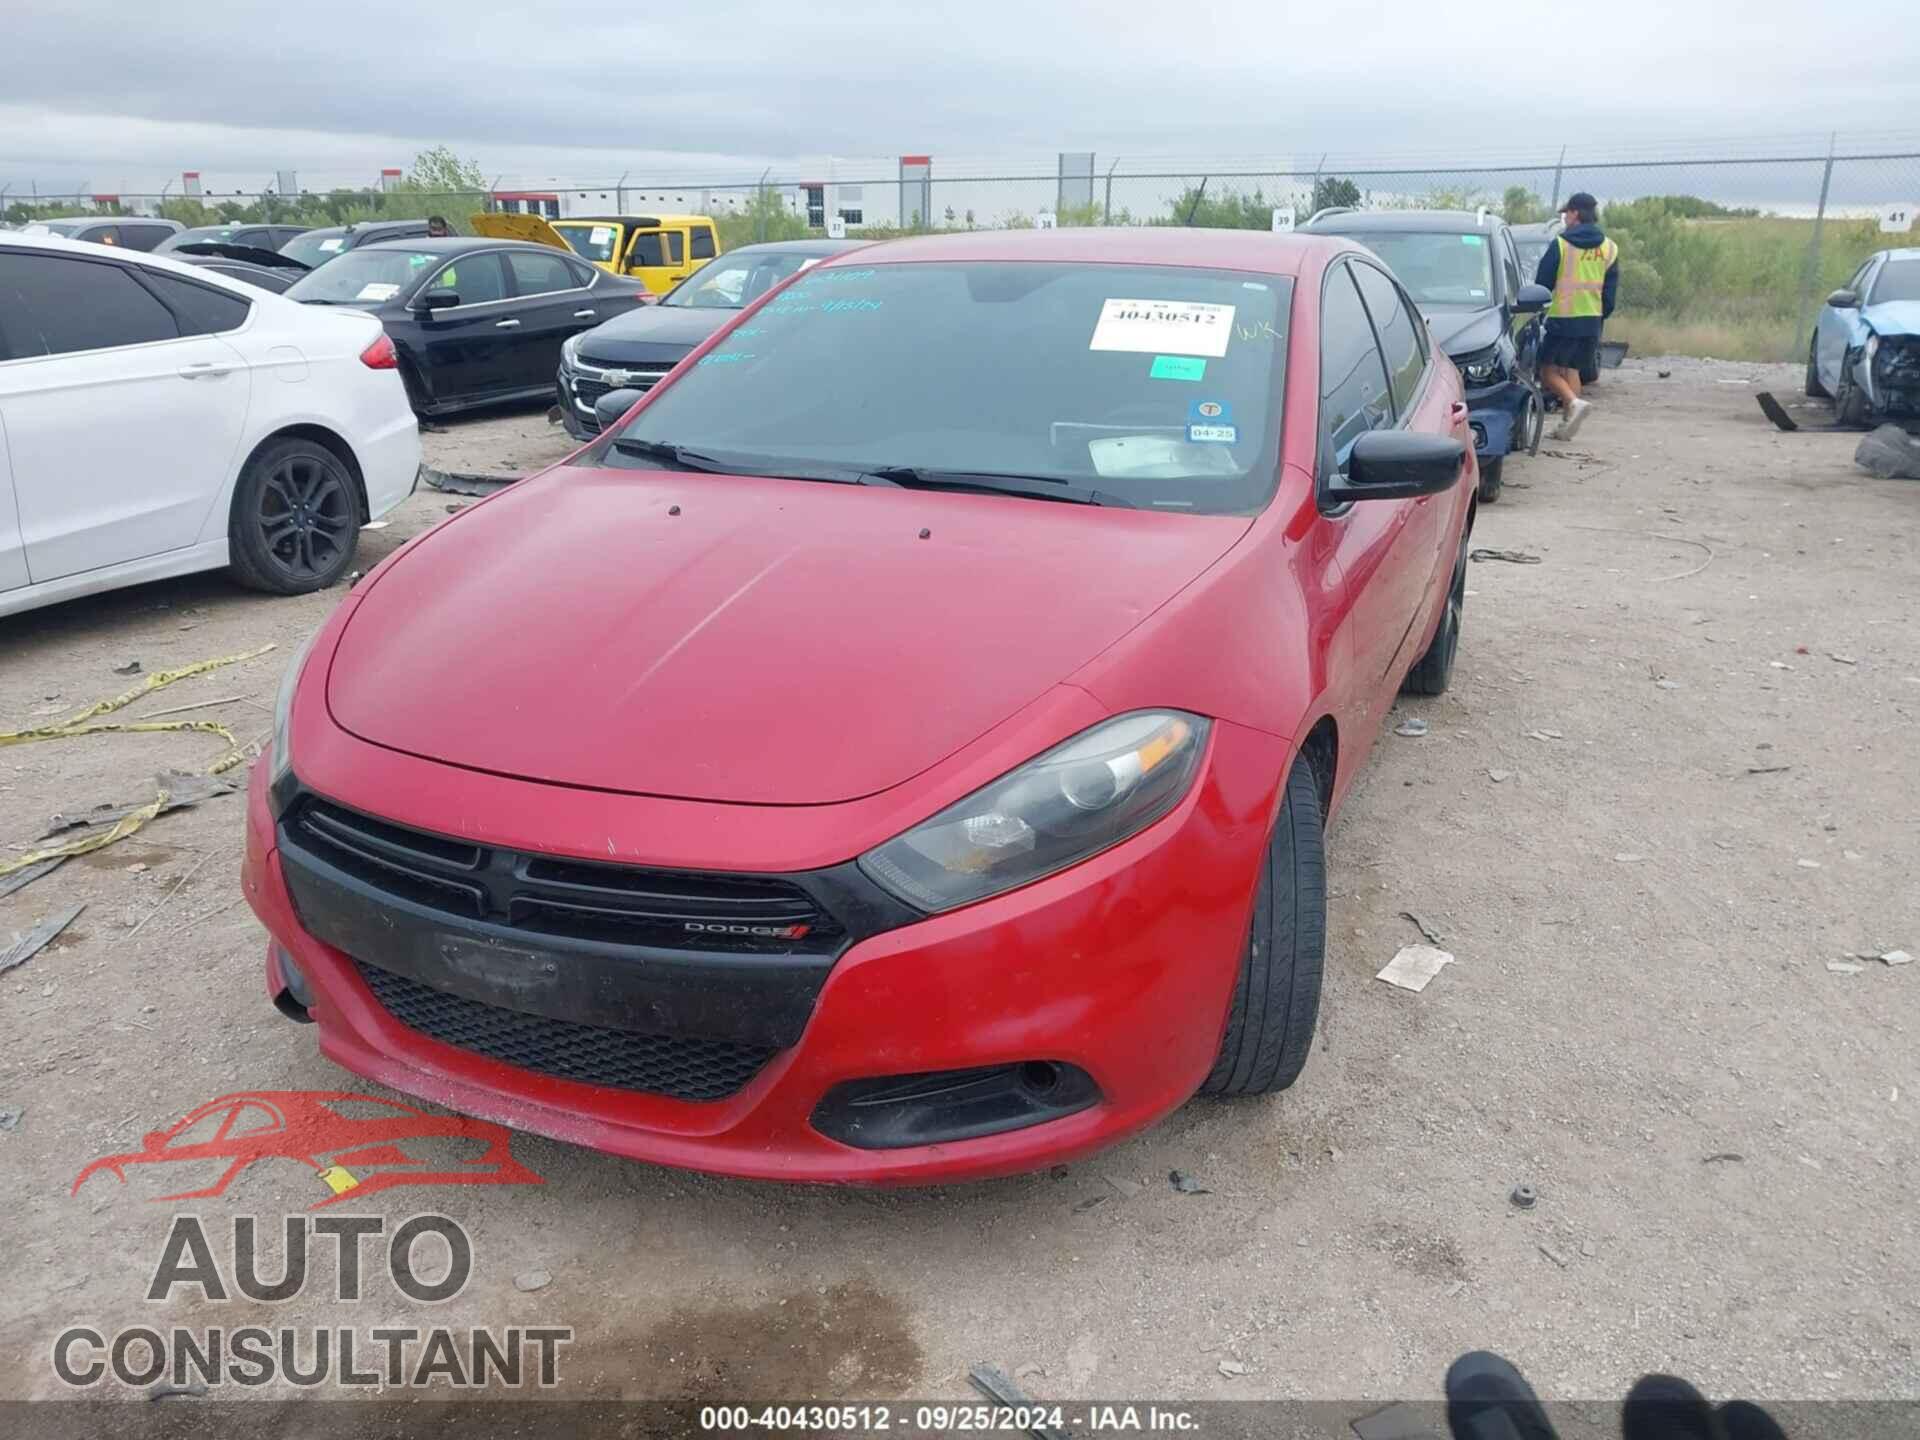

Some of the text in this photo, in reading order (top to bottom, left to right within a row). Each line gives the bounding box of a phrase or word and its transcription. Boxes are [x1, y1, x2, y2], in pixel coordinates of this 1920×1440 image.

[1888, 211, 1905, 223] 41
[1113, 310, 1217, 325] 40430512
[1192, 428, 1235, 439] 04-25
[684, 922, 793, 937] DODGE
